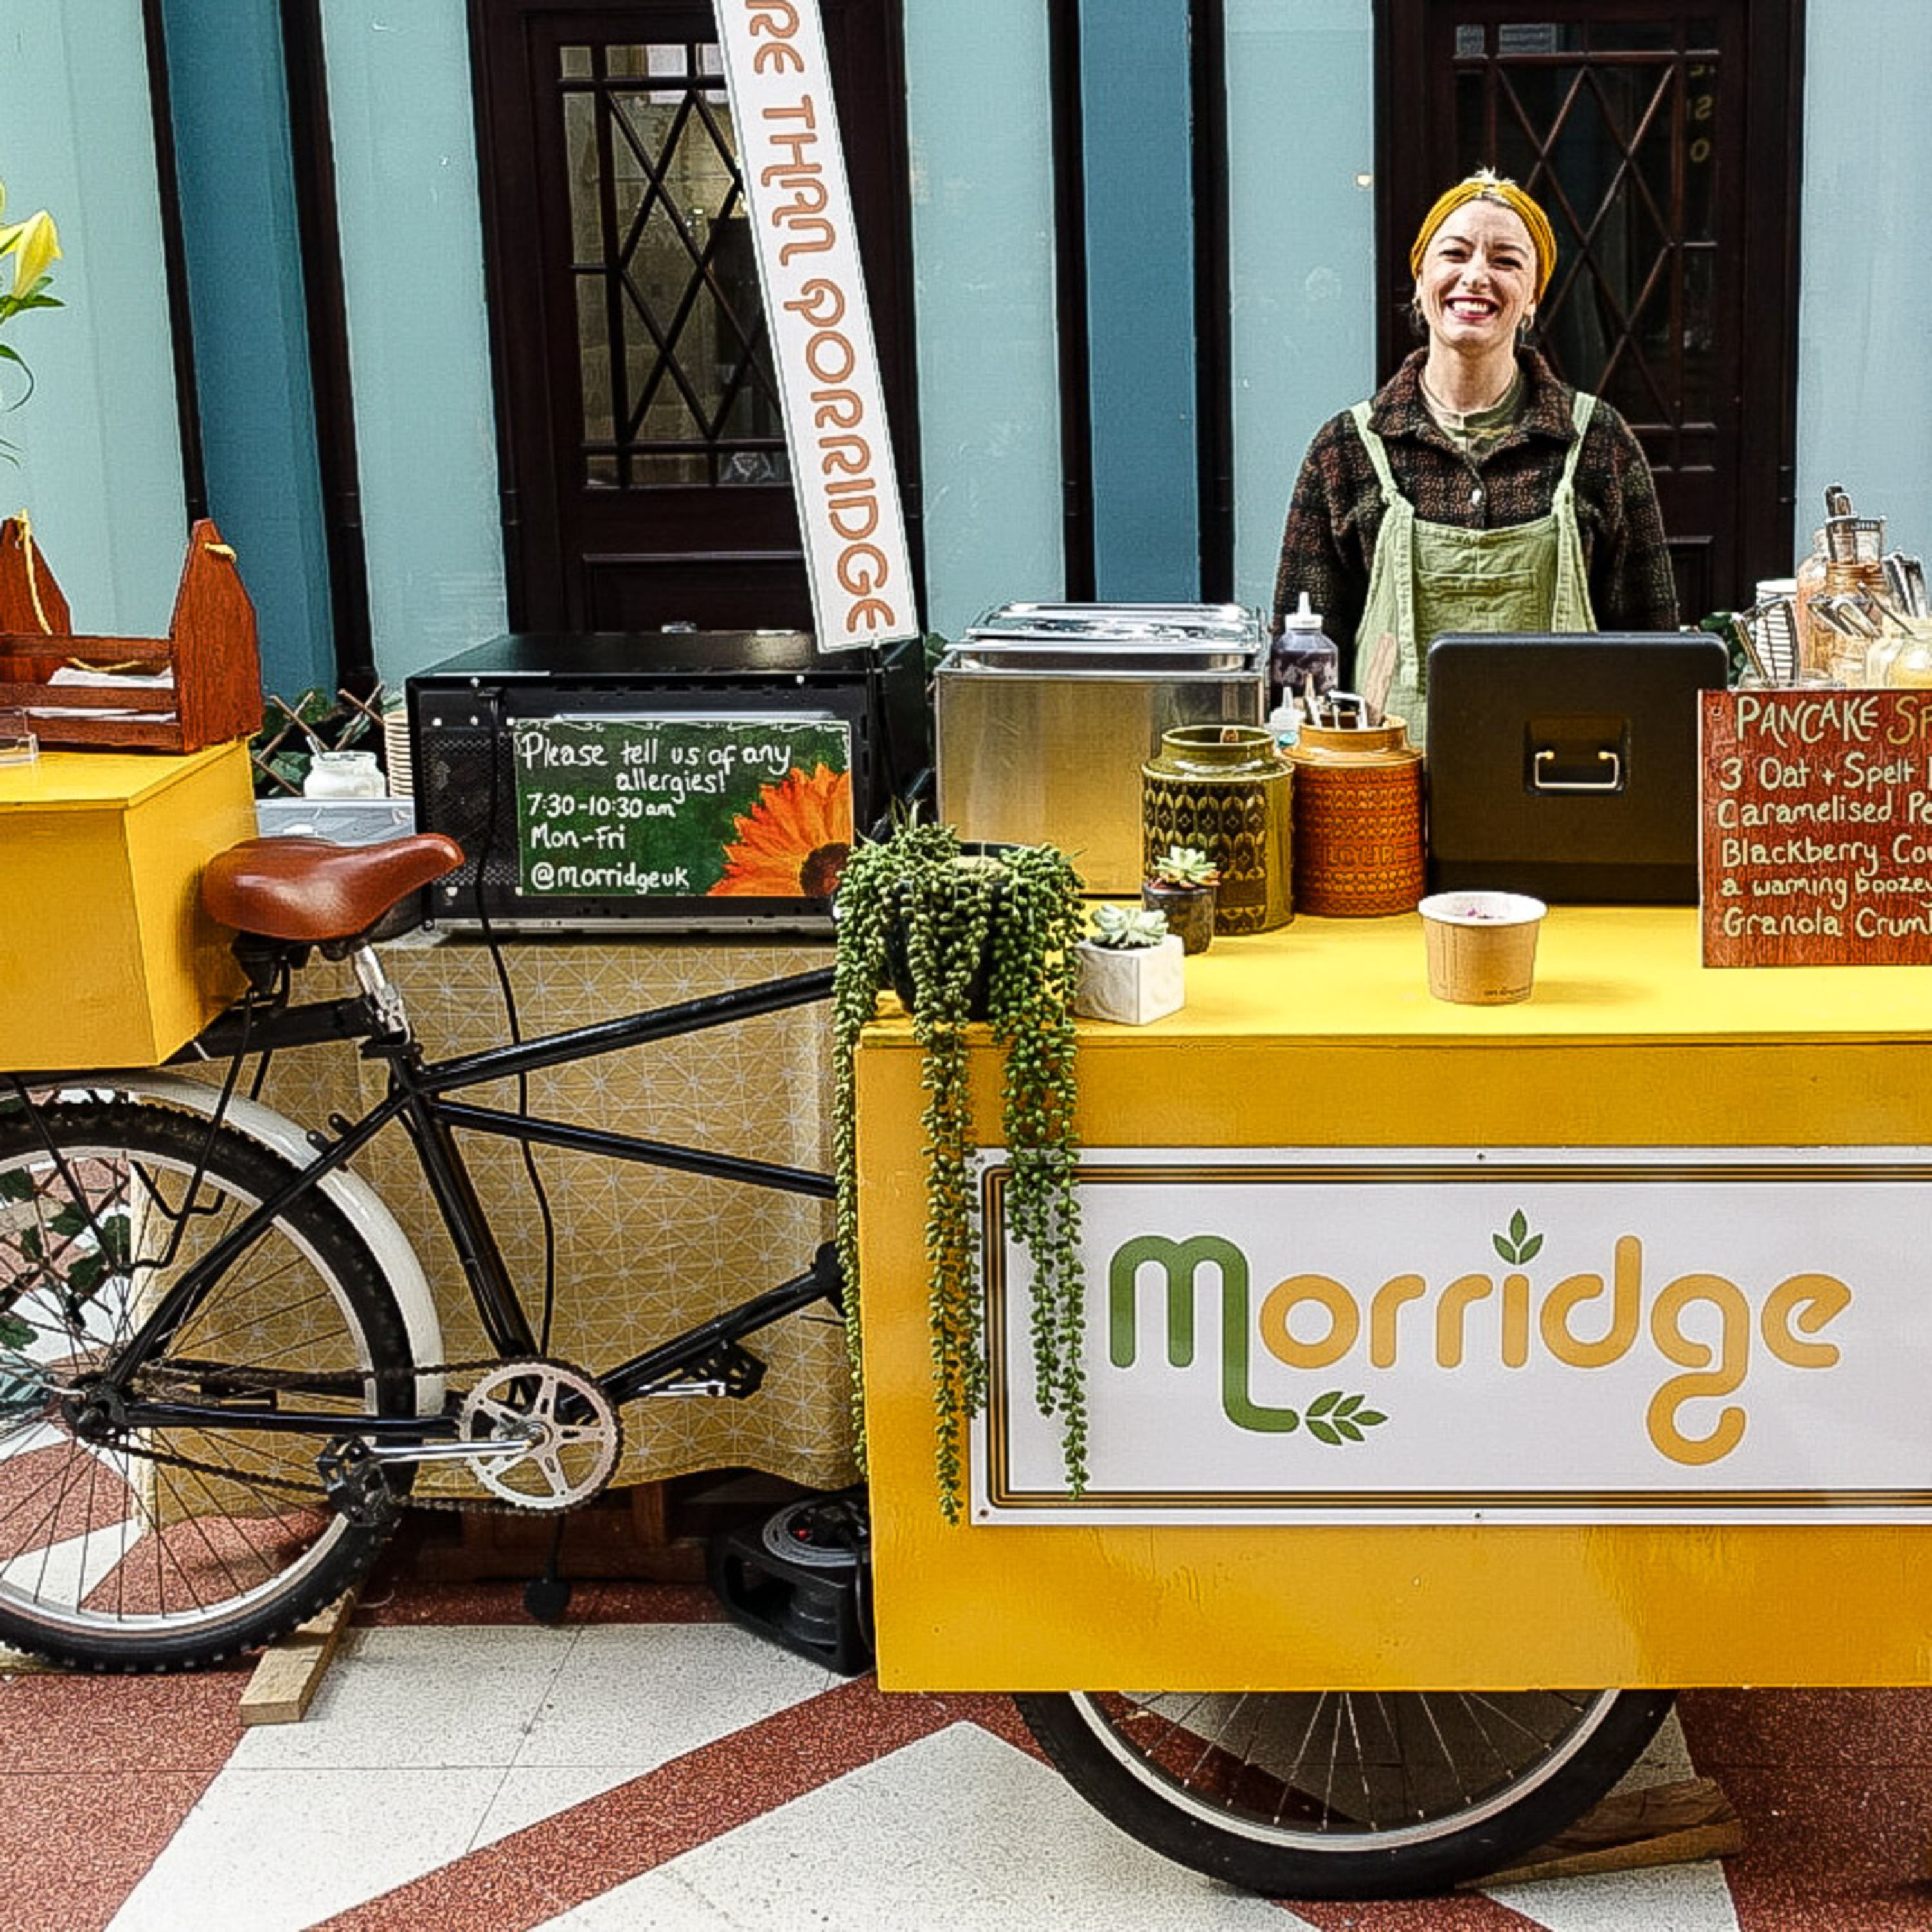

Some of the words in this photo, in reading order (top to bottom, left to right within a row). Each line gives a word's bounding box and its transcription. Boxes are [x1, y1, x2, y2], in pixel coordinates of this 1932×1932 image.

[745, 0, 804, 74] RE
[761, 94, 837, 266] THAN
[783, 278, 896, 634] PORRIDGE
[1738, 696, 1879, 748] PANCAKE
[522, 731, 608, 769] Please
[620, 738, 658, 765] tell
[671, 745, 699, 765] us
[708, 744, 737, 773] of
[742, 743, 791, 775] any
[1719, 757, 1743, 790] 3
[1759, 757, 1810, 790] Oat
[1843, 751, 1915, 793] Spelt
[615, 770, 726, 804] allergies!
[1718, 789, 1892, 828] Caramelised
[531, 822, 625, 849] Mon-Fri
[1722, 837, 1879, 876] Blackberry
[531, 862, 689, 894] @morridgeuk
[1720, 878, 1743, 896] a
[1752, 871, 1847, 910] warming
[1724, 907, 1843, 938] Granola
[1855, 907, 1932, 938] Crum
